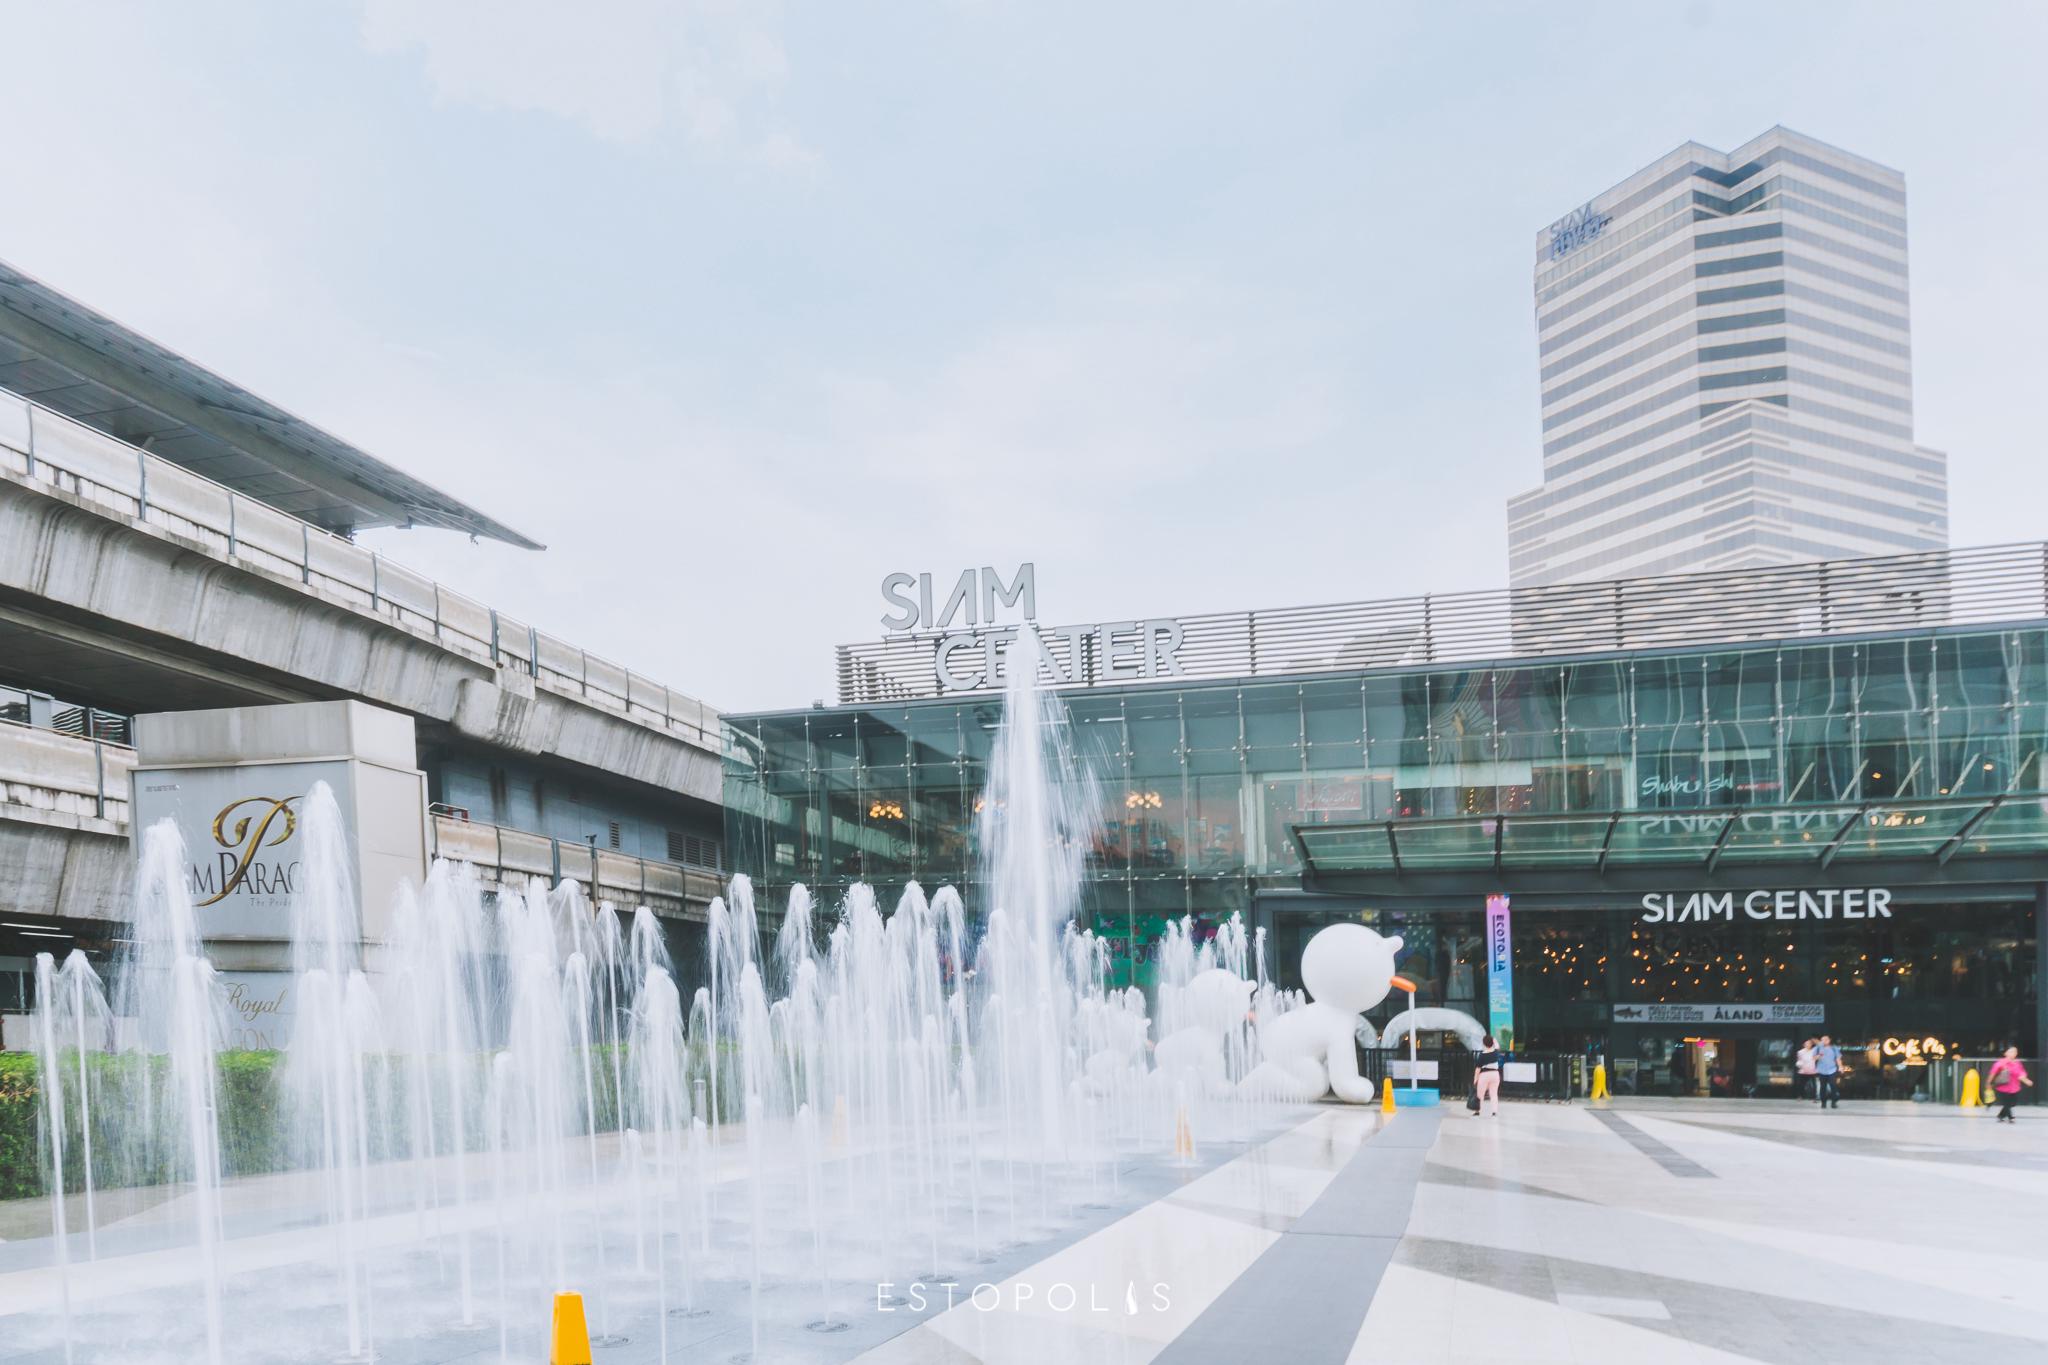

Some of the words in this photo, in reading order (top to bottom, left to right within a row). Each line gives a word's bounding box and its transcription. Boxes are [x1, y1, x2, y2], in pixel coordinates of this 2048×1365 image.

[880, 562, 1036, 631] SIAM
[1641, 892, 1734, 923] SIAM
[1744, 888, 1893, 920] CENTER
